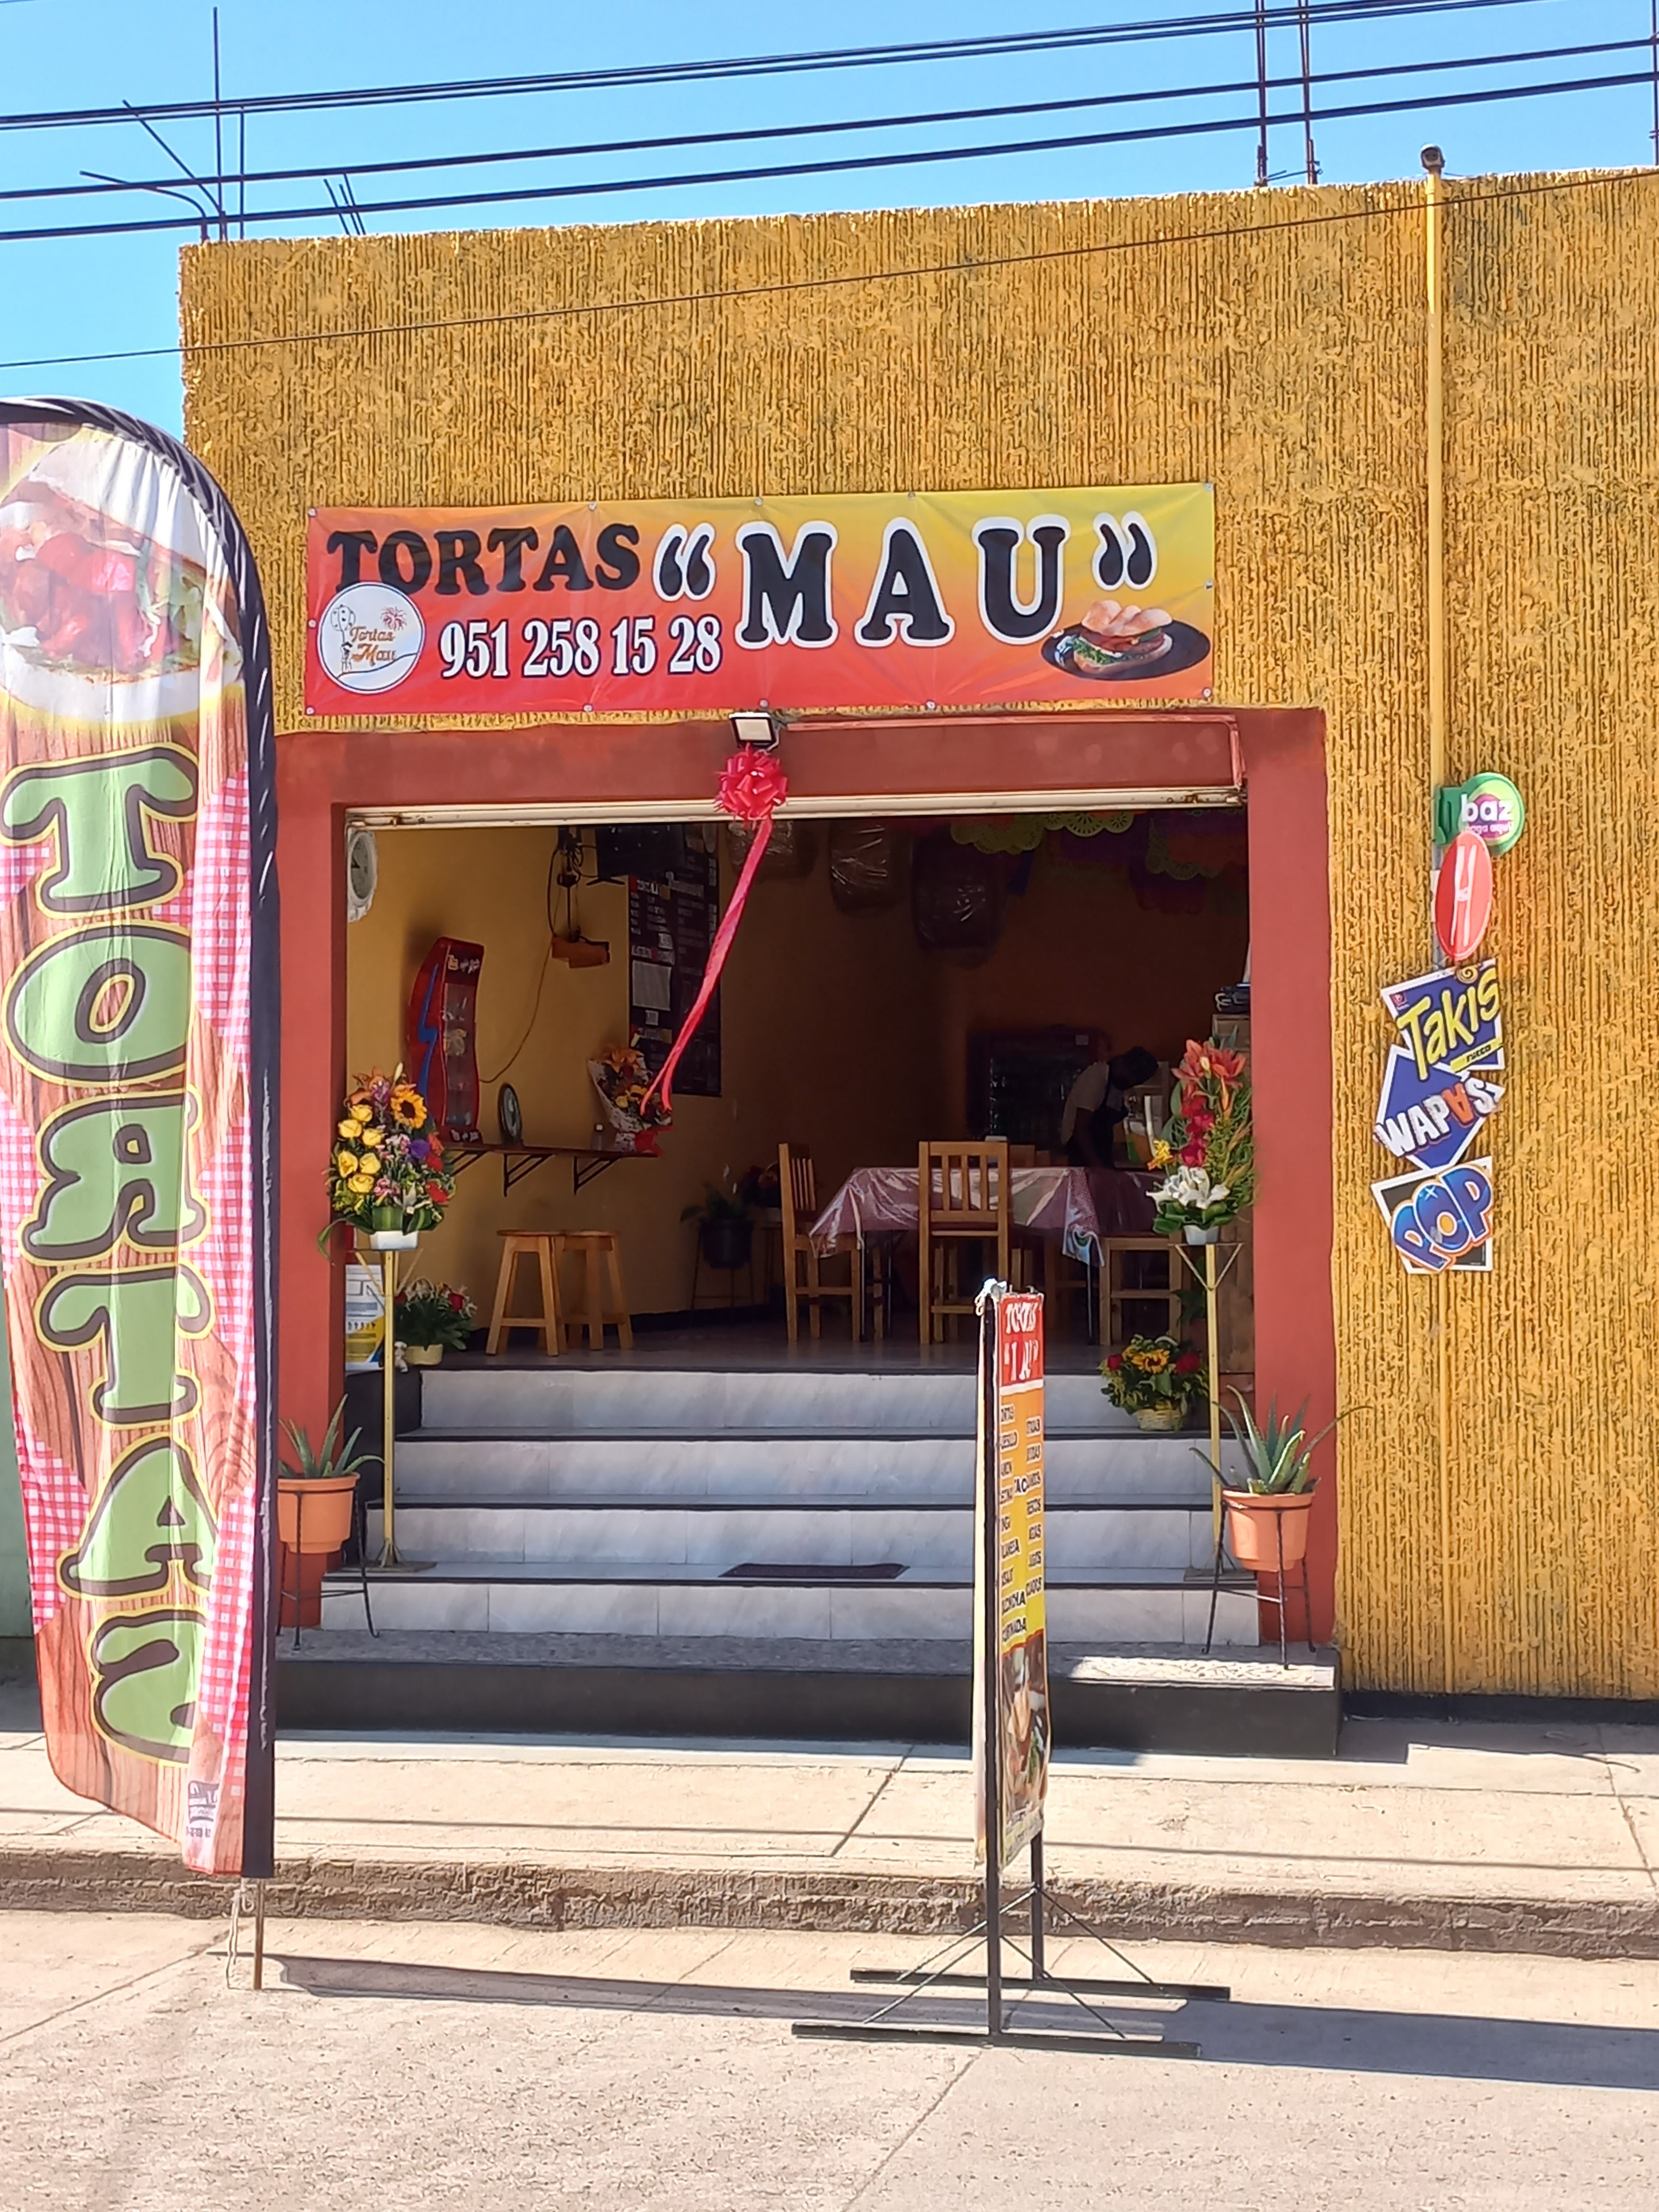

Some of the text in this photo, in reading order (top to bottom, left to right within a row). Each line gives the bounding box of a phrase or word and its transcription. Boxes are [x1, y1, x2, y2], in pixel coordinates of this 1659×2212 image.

[327, 523, 640, 595] TORTAS
[349, 626, 395, 642] Tortas
[440, 613, 722, 678] 951 258 15 28
[1460, 793, 1514, 822] baz
[1391, 1163, 1493, 1273] POP
